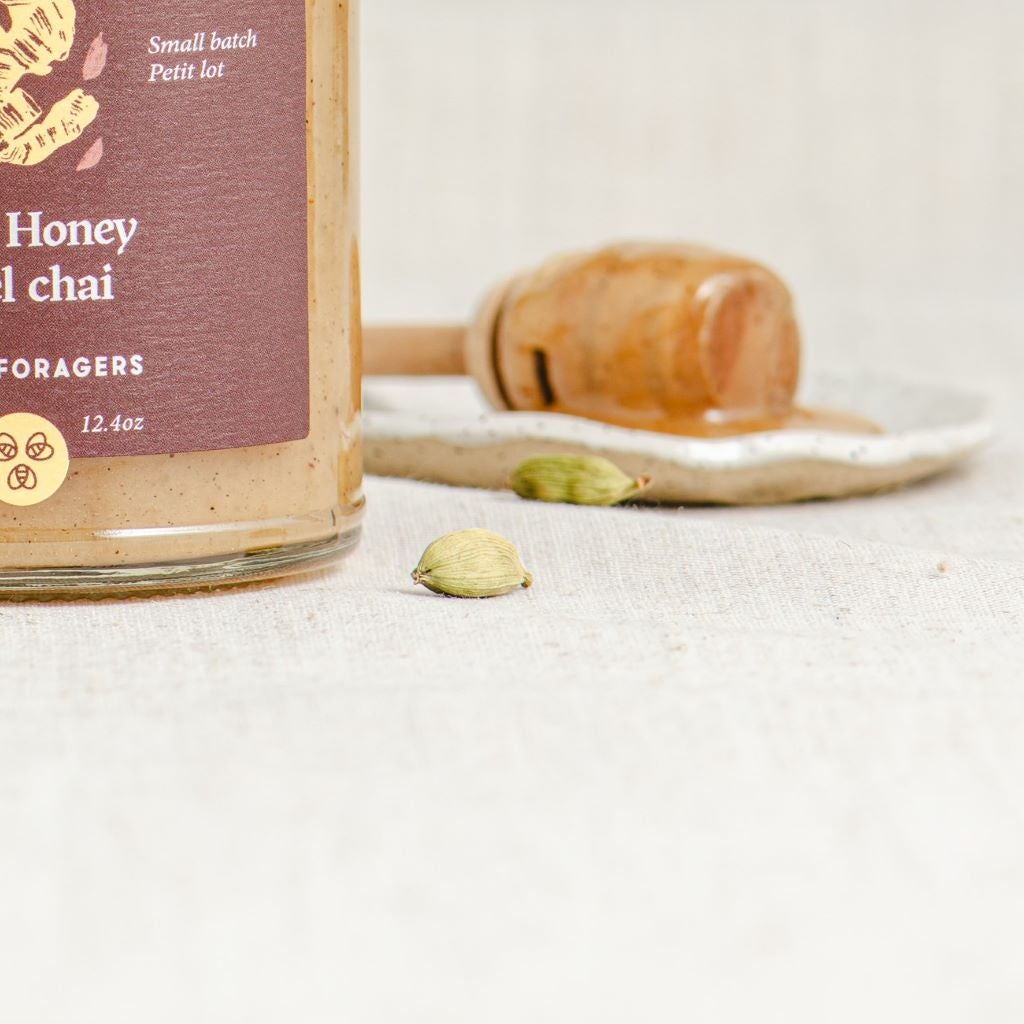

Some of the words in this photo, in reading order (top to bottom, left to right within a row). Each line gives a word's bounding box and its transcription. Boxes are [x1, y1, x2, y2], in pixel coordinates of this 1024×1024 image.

[147, 32, 206, 55] Small
[209, 28, 258, 51] batch
[147, 60, 196, 83] Petit
[199, 58, 226, 80] lot
[5, 211, 139, 256] Honey
[28, 262, 115, 304] chai
[80, 414, 145, 435] 12.4oz
